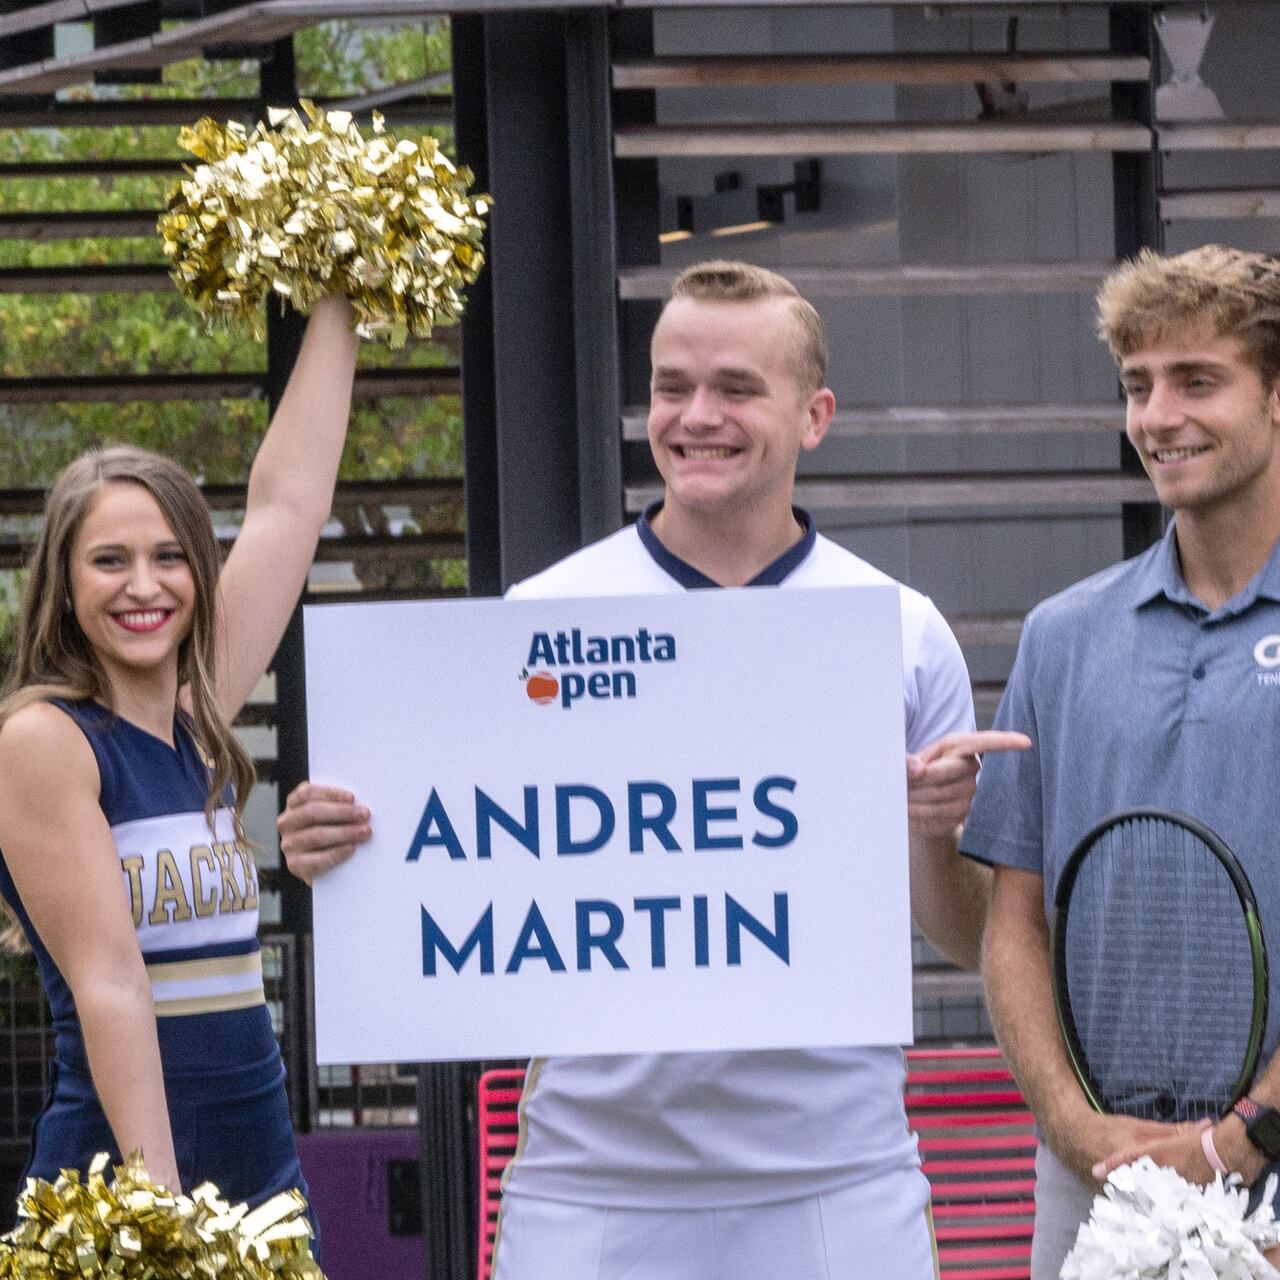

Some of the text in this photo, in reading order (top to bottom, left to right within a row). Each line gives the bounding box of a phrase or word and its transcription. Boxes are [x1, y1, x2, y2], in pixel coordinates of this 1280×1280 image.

[526, 627, 677, 668] Atlanta
[404, 774, 800, 863] ANDRES
[419, 890, 791, 978] MARTIN
